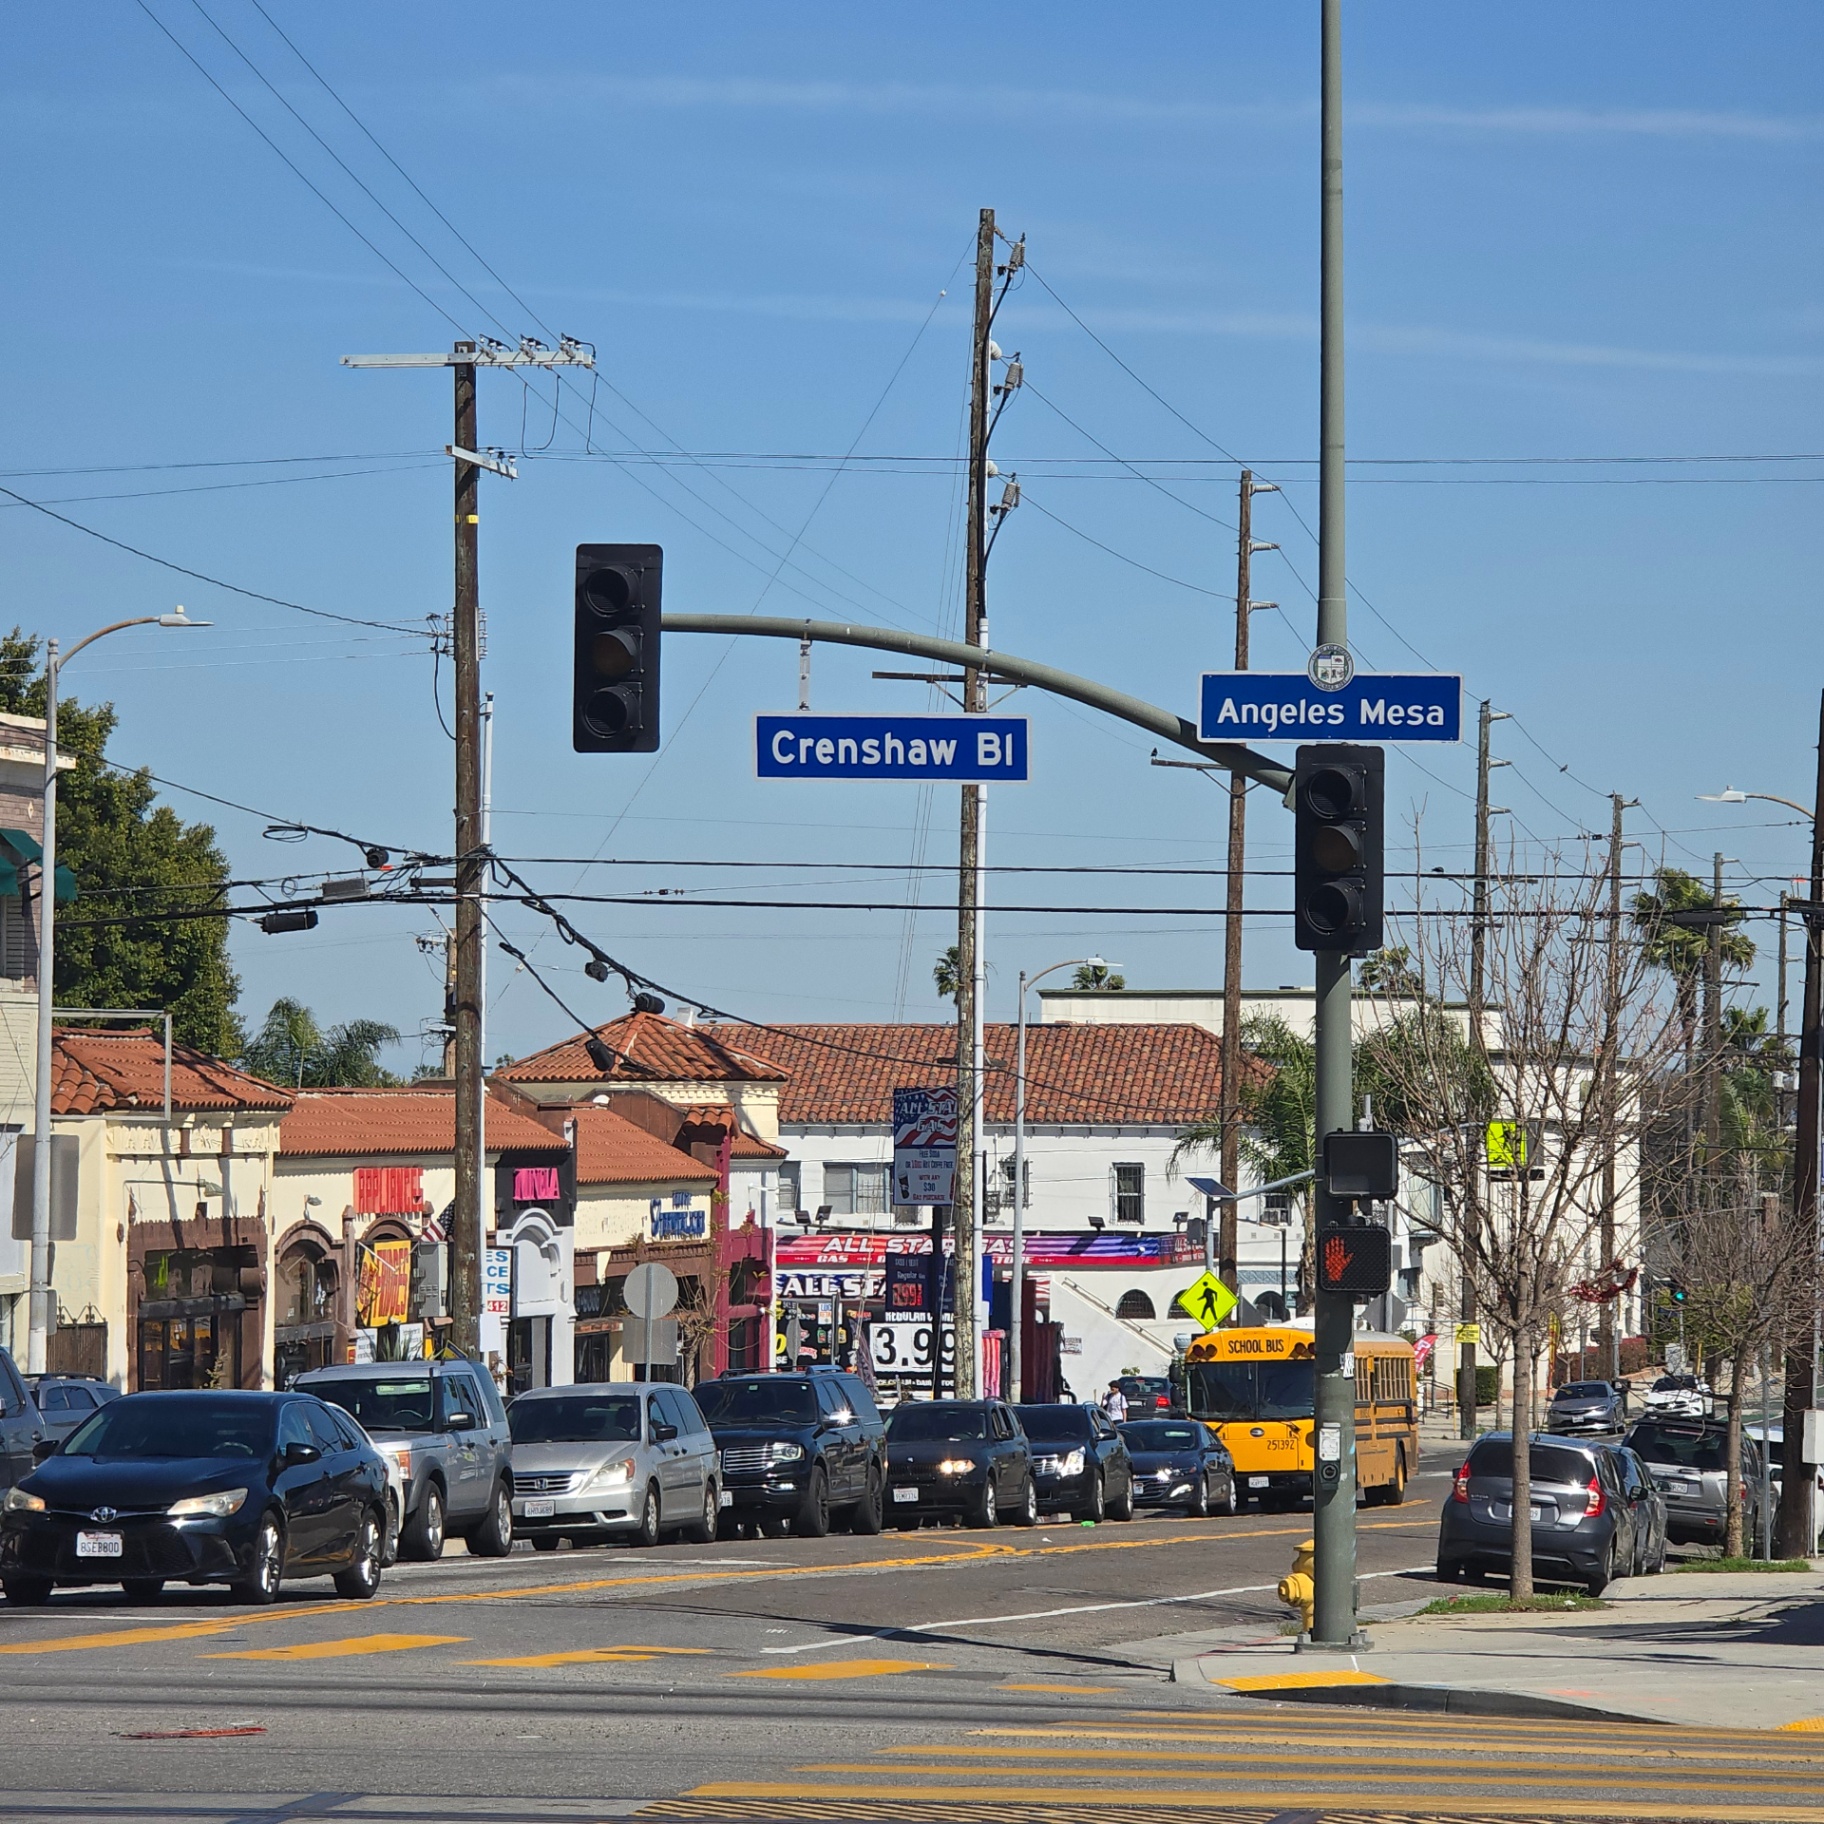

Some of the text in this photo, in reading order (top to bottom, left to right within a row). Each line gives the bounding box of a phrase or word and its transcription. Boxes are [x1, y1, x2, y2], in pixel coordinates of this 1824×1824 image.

[1218, 699, 1444, 732] Angeles Mesa
[773, 731, 1012, 765] Crenshaw Bl
[900, 1102, 922, 1114] ALL
[917, 1119, 943, 1132] GAS
[923, 1182, 935, 1191] $30
[822, 1237, 874, 1253] ALL
[816, 1255, 848, 1263] GAS
[487, 1266, 508, 1277] CE
[783, 1278, 840, 1296] ALL
[1228, 1339, 1284, 1354] SCHOOL BUS
[1267, 1440, 1294, 1450] 251392
[81, 1542, 119, 1553] 8SEB800
